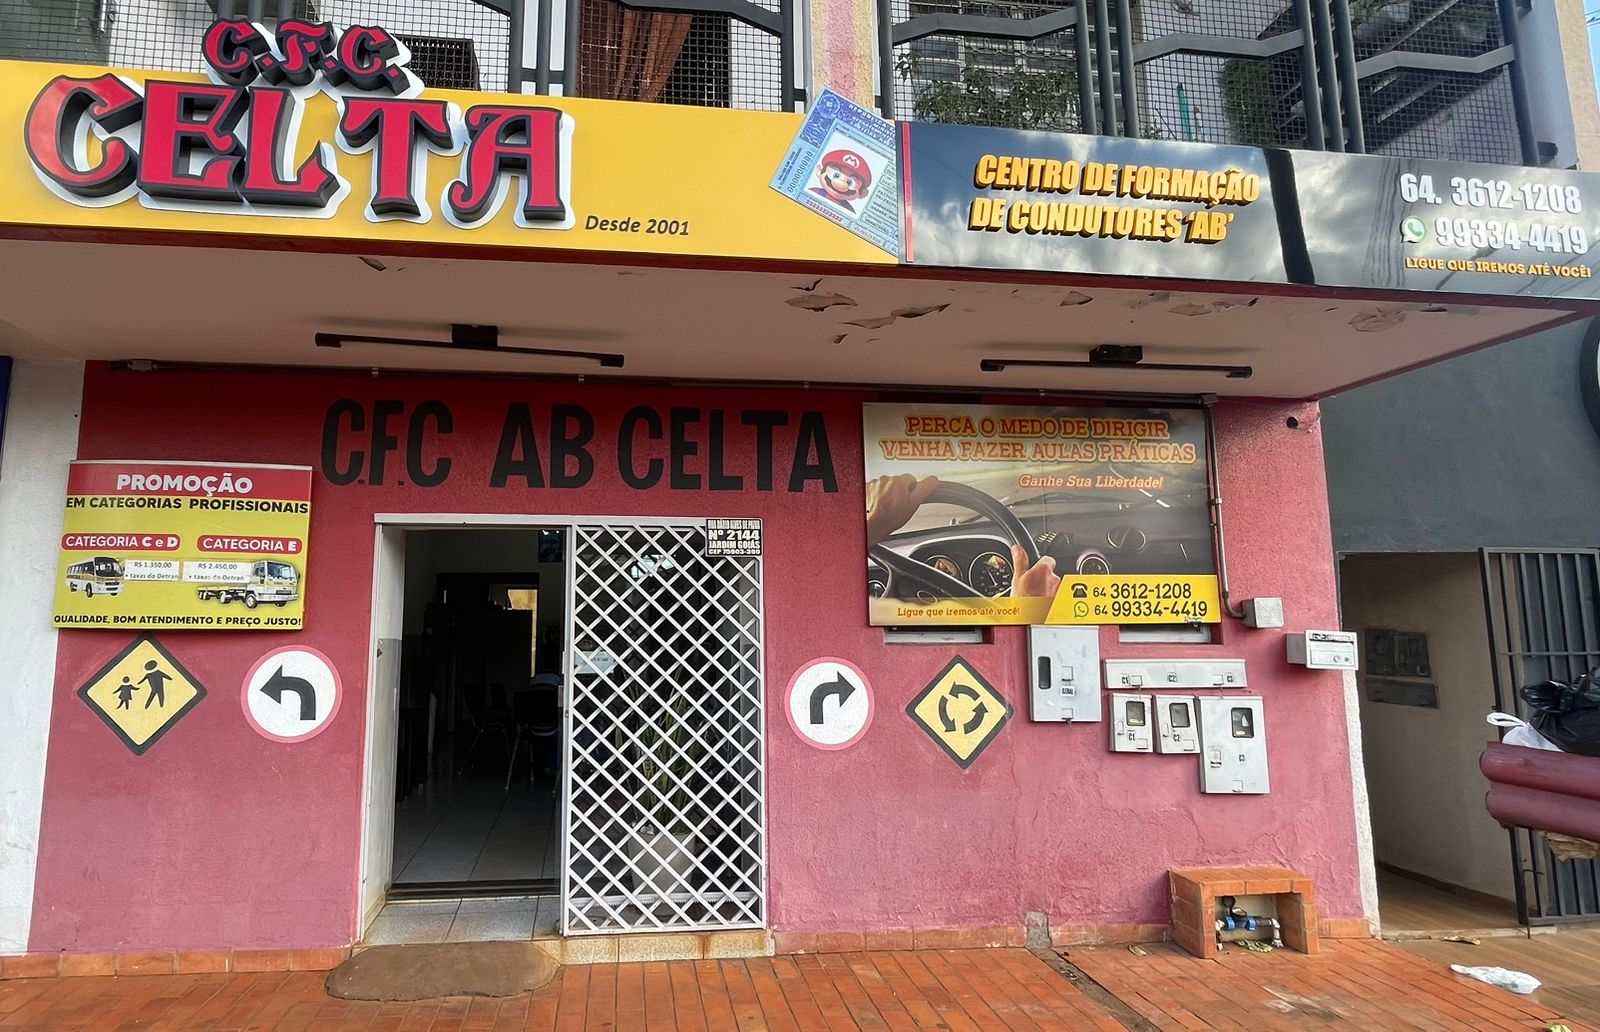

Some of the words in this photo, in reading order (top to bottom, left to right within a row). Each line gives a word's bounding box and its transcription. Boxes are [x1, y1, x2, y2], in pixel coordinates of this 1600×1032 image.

[24, 73, 567, 222] CELTA
[976, 153, 1080, 190] CENTRO
[1081, 161, 1117, 194] DE
[1121, 165, 1260, 208] FORMAÇÃO
[1400, 172, 1442, 204] 64.
[1450, 176, 1582, 214] 3612-1208
[585, 215, 641, 233] Desde
[645, 218, 690, 236] 2001
[969, 196, 1004, 232] DE
[1007, 200, 1182, 240] CONDUTORES
[1435, 216, 1588, 255] 99334-4419
[1406, 257, 1444, 270] LIGUE
[1449, 259, 1474, 272] QUE
[1476, 261, 1525, 275] IREMOS
[1527, 262, 1551, 277] ATÉ
[1554, 264, 1592, 279] VOCÊ!
[907, 417, 974, 436] PERCA
[980, 418, 995, 435] O
[1000, 418, 1056, 436] MEDO
[1061, 419, 1088, 437] DE
[1092, 421, 1168, 439] DIRIGIR
[489, 403, 595, 489] AB
[617, 405, 838, 494] CELTA
[881, 440, 958, 459] VENHA
[961, 441, 1026, 460] FAZER
[1032, 442, 1095, 461] AULAS
[1099, 438, 1195, 462] PRÁTICAS
[116, 473, 253, 497] PROMOÇÃO
[1019, 474, 1064, 489] Ganhe
[1066, 475, 1092, 489] Sua
[1095, 475, 1163, 489] Liberdade!
[66, 497, 86, 508] EM
[89, 497, 182, 509] CATEGORIAS
[189, 498, 309, 514] PROFISSIONAIS
[65, 535, 138, 549] CATEGORIA
[141, 537, 152, 549] C
[155, 539, 164, 549] e
[167, 537, 178, 549] D
[202, 537, 285, 552] CATEGORIA
[288, 540, 297, 552] E
[708, 540, 737, 549] JARDIM
[737, 540, 760, 549] GOIÁS
[726, 529, 760, 541] 2144
[1092, 587, 1106, 598] 64
[1110, 582, 1191, 599] 3612-1208
[897, 607, 923, 619] Ligue
[925, 609, 945, 619] que
[946, 607, 978, 617] iremos
[978, 607, 994, 617] até
[996, 607, 1021, 617] você!
[1094, 605, 1109, 617] 64
[1112, 601, 1207, 617] 99334-4419
[54, 615, 110, 624] QUALIDADE,
[113, 615, 137, 624] BOM
[139, 616, 214, 625] ATENDIMENTO
[225, 617, 261, 627] PREÇO
[264, 618, 301, 626] JUSTO!
